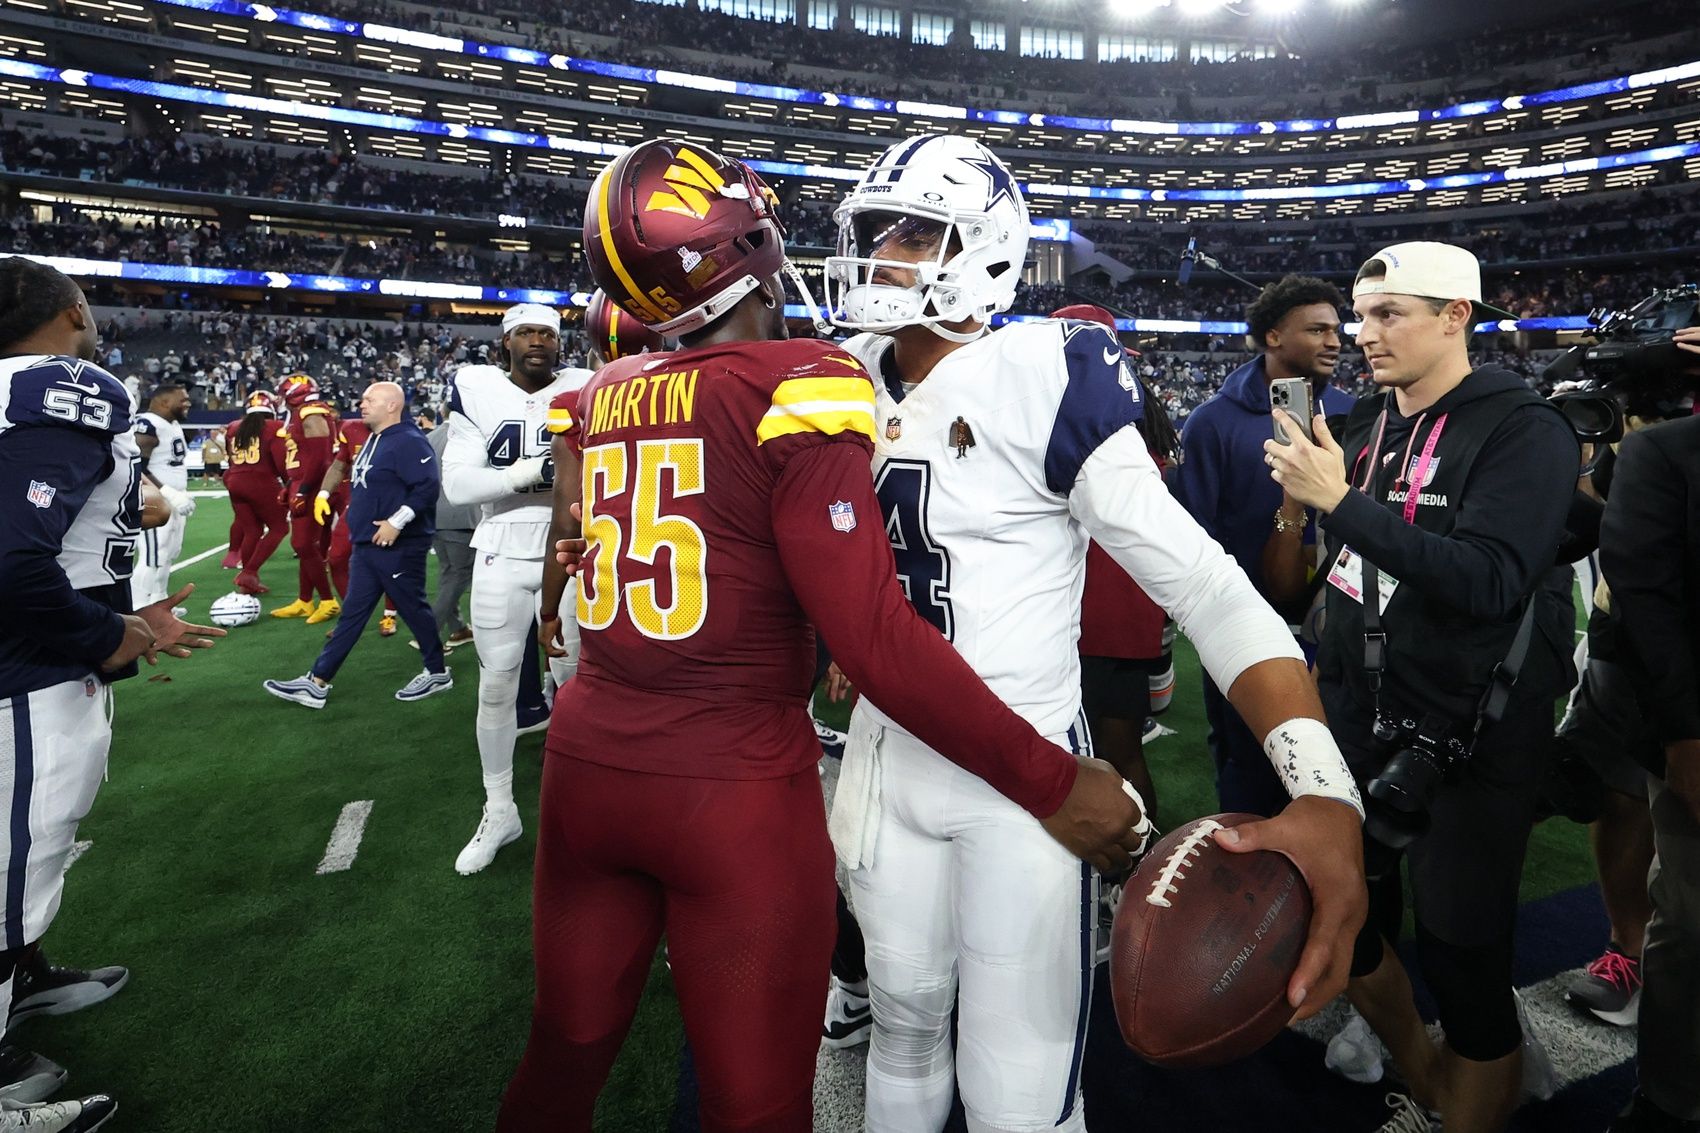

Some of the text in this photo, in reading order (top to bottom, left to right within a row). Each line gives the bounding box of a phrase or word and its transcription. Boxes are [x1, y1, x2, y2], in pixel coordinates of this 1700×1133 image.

[860, 185, 892, 194] COWBOYS
[587, 369, 700, 437] MARTIN
[1118, 360, 1140, 403] 4
[42, 388, 113, 431] 53
[31, 489, 49, 505] NFL
[1387, 490, 1448, 507] SOCIA MEDIA
[576, 437, 708, 642] 55
[835, 514, 855, 528] NFL
[872, 457, 955, 643] 4
[1418, 734, 1437, 745] SONY
[1213, 943, 1257, 995] NATIONAL
[1255, 892, 1290, 941] FOOTBALL
